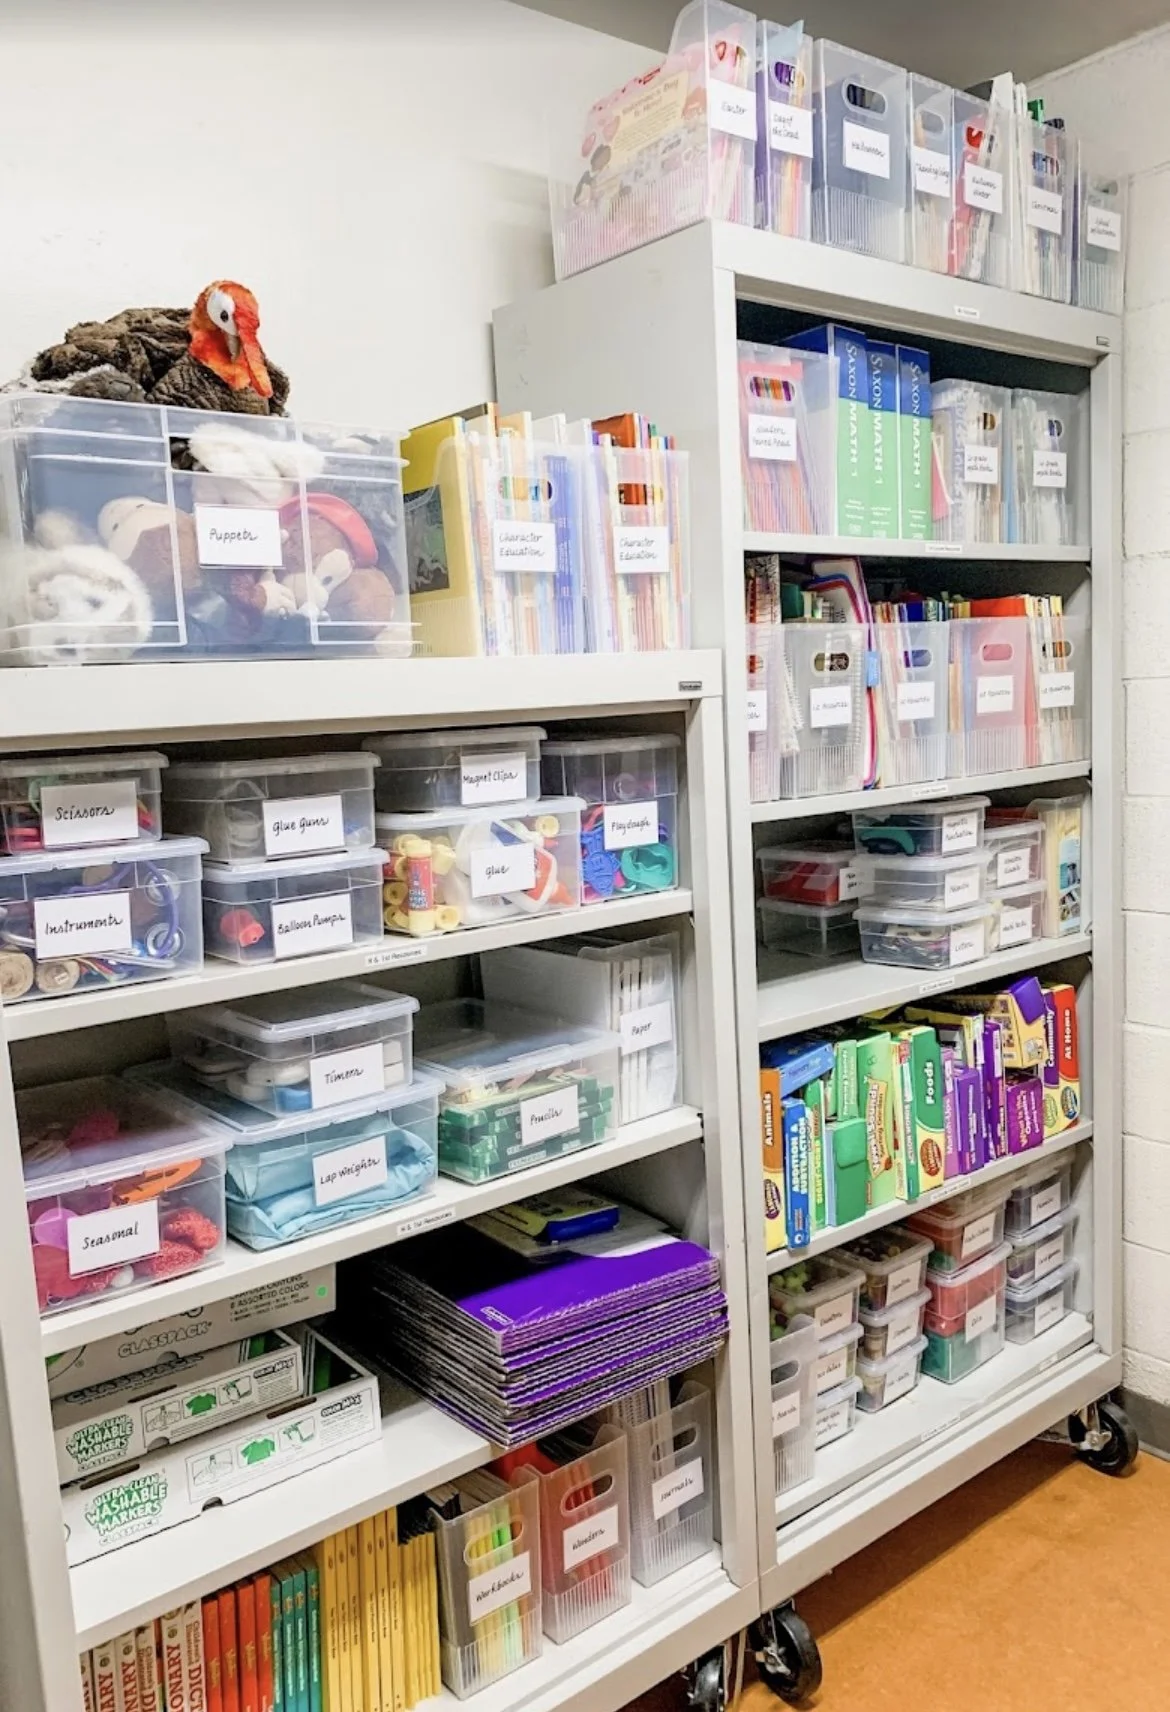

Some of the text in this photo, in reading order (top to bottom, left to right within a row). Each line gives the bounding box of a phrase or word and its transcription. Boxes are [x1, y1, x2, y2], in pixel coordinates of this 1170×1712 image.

[846, 341, 858, 400] SAXON
[871, 354, 882, 410] SAXON
[910, 361, 921, 414] SAXON
[849, 401, 860, 468] MATH
[872, 411, 883, 476] MATH
[912, 416, 922, 476] MATH
[209, 527, 259, 542] Puppets
[499, 531, 543, 544] Character
[619, 537, 655, 549] Character
[499, 547, 544, 558] Education
[619, 551, 658, 562] Education
[463, 769, 519, 788] Magnet Clips
[55, 805, 116, 822] Scissors
[611, 815, 652, 836] Playdough
[45, 915, 123, 936] Instruments
[277, 913, 347, 934] Balloon Pumps
[631, 1021, 652, 1036] Paper
[1063, 1008, 1072, 1044] Home
[325, 1067, 364, 1085] Timers
[924, 1060, 935, 1105] Foods
[529, 1107, 563, 1125] Pencils
[764, 1091, 775, 1147] Animals
[320, 1157, 381, 1185] Lap Weights
[791, 1136, 802, 1193] ADDITION
[82, 1221, 140, 1250] Seasonal
[237, 1291, 278, 1307] ASSORTED
[278, 1281, 310, 1296] COLORS
[66, 1421, 134, 1458] WASHABLE
[77, 1438, 129, 1465] MARKERS
[92, 1472, 161, 1507] ULTRA-CLEAN
[659, 1476, 694, 1502] Journals
[85, 1482, 168, 1527] WASHABLE
[98, 1500, 162, 1537] MARKERS
[572, 1527, 606, 1550] Wonders
[475, 1571, 525, 1602] Workbooks
